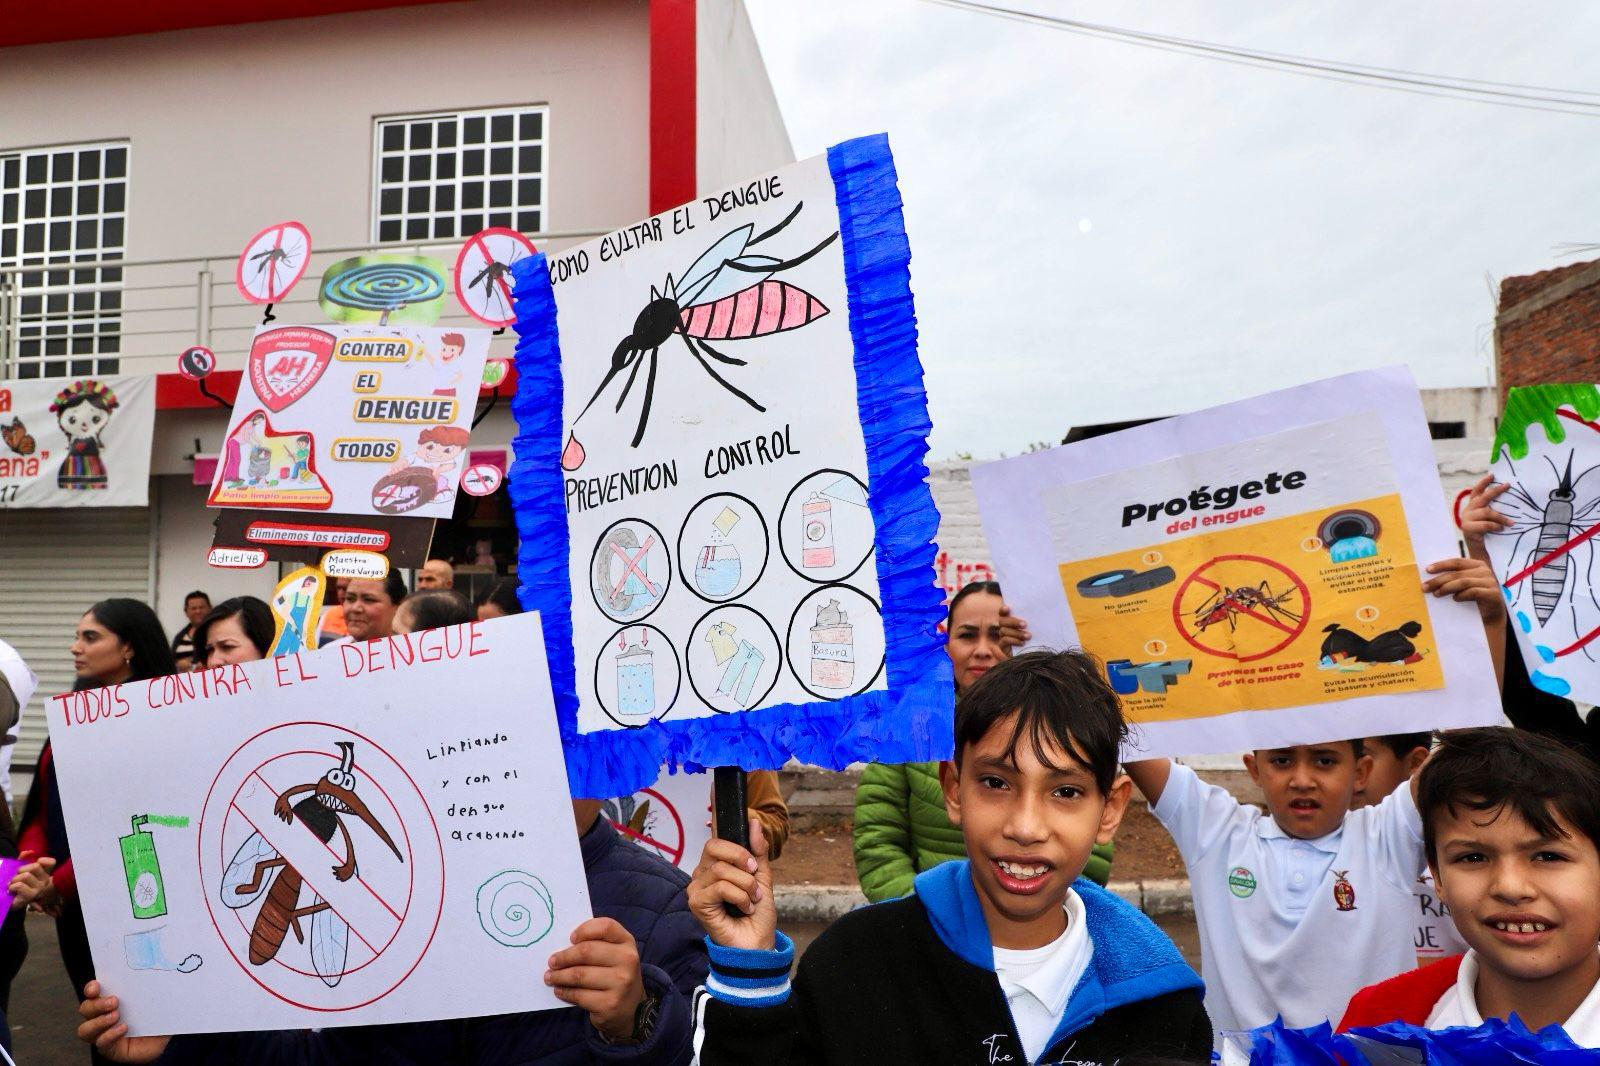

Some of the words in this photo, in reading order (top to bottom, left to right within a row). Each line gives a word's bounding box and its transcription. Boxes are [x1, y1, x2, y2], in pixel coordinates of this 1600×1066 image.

[549, 250, 589, 285] COMO
[600, 217, 663, 262] EVITAR
[673, 207, 695, 234] EL
[703, 176, 783, 221] DENGUE
[339, 342, 406, 356] CONTRA
[268, 356, 310, 376] AH
[253, 358, 273, 401] AGUSTINA
[357, 375, 376, 388] EL
[357, 400, 453, 420] DENGUE
[338, 443, 396, 458] TODOS
[704, 424, 800, 479] CONTROL
[564, 460, 678, 513] PREVENTION
[1121, 470, 1307, 528] Protégete
[1166, 516, 1197, 535] del
[1201, 504, 1266, 527] engue
[248, 529, 308, 541] Eliminemos
[312, 532, 328, 542] los
[331, 532, 384, 545] criaderos
[209, 551, 243, 564] Adriel
[328, 555, 367, 564] Maestra
[357, 567, 384, 577] Vargas
[1319, 566, 1349, 575] Limpia
[1330, 580, 1354, 588] evitar
[1368, 574, 1390, 583] agua
[813, 644, 847, 657] Basura
[53, 684, 130, 726] TODOS
[149, 664, 252, 709] CONTRA
[274, 652, 318, 687] EL
[341, 619, 490, 677] DENGUE
[1276, 662, 1304, 670] caso
[1257, 672, 1301, 684] muerte
[1358, 670, 1415, 682] acumulación
[1338, 683, 1367, 692] basura
[426, 733, 507, 760] Linpiando
[466, 774, 491, 785] con
[504, 769, 518, 779] el
[451, 829, 525, 841] acabando
[1413, 893, 1451, 917] RA
[982, 1033, 1013, 1064] The
